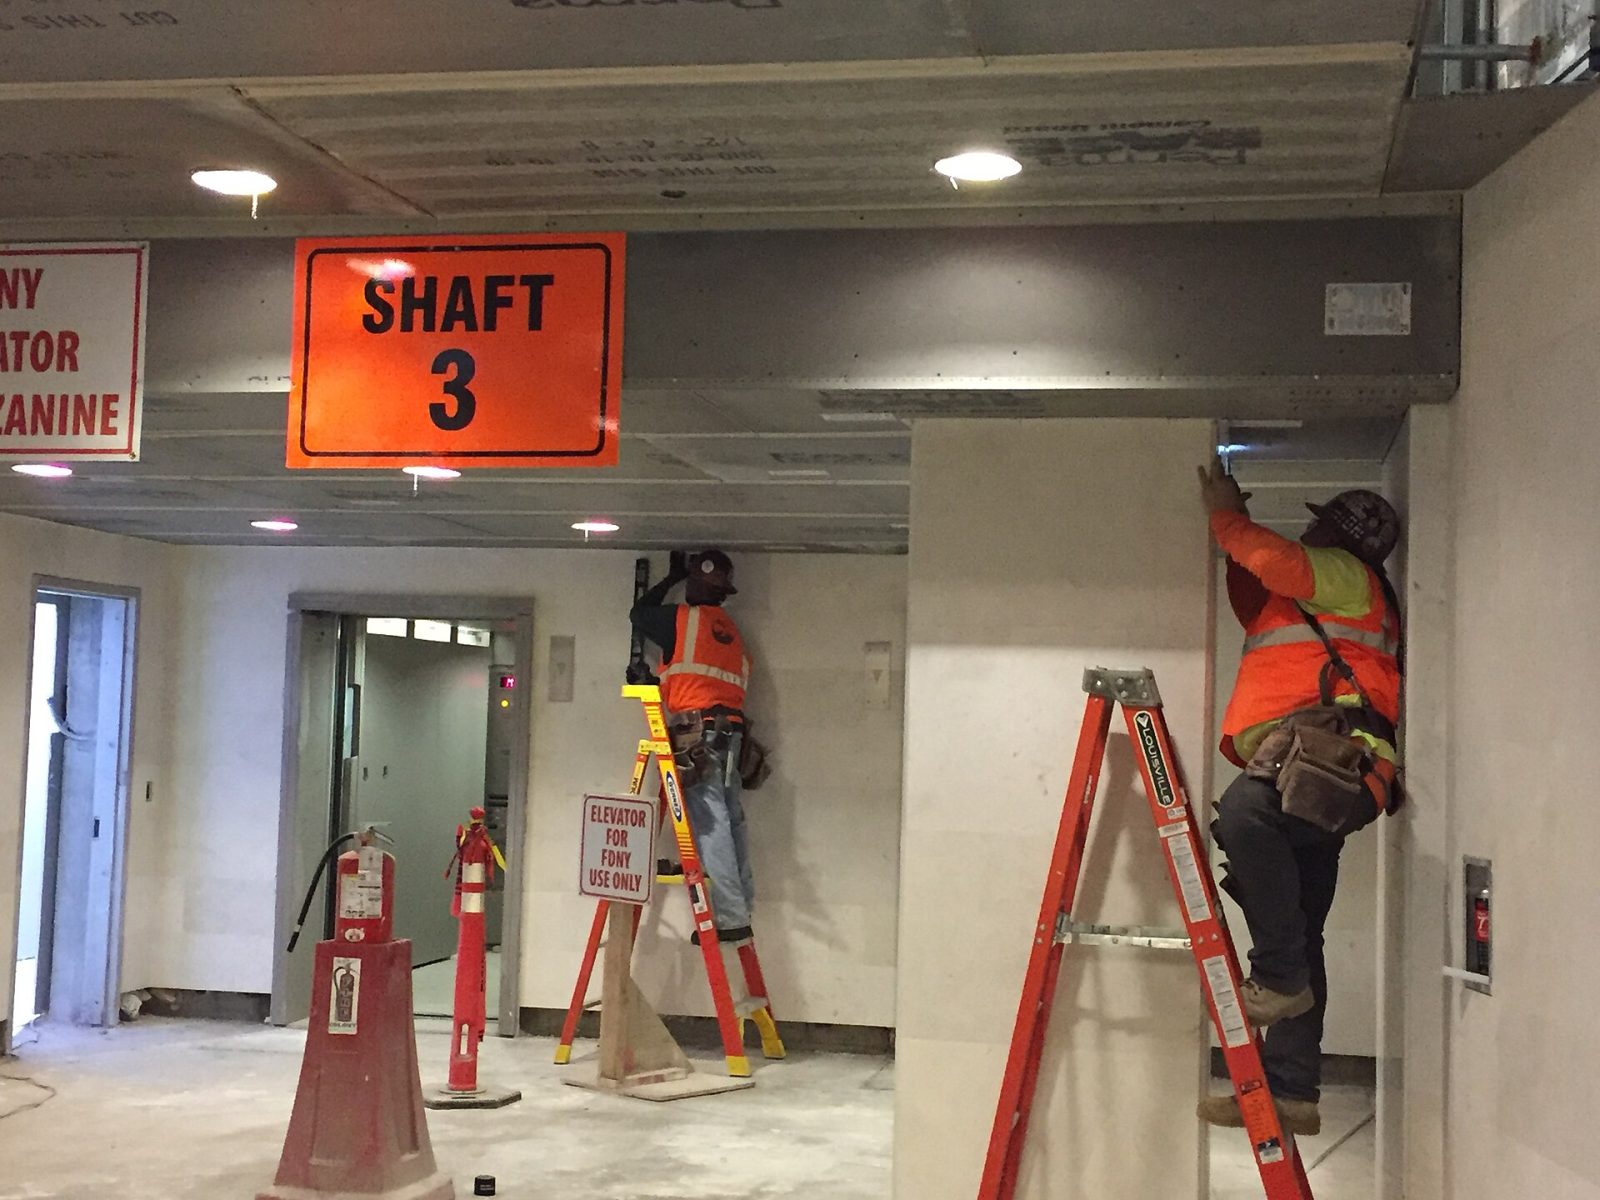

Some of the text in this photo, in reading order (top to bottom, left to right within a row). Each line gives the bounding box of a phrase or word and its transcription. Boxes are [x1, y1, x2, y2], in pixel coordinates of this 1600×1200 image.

[362, 273, 554, 334] SHAFT
[428, 348, 477, 431] 3
[0, 393, 119, 437] ANINE
[1142, 727, 1171, 806] LOUISVILLE
[591, 805, 646, 828] ELEVATOR
[606, 828, 628, 848] FOR
[601, 849, 632, 869] FDNY
[589, 868, 642, 892] USE ONLY
